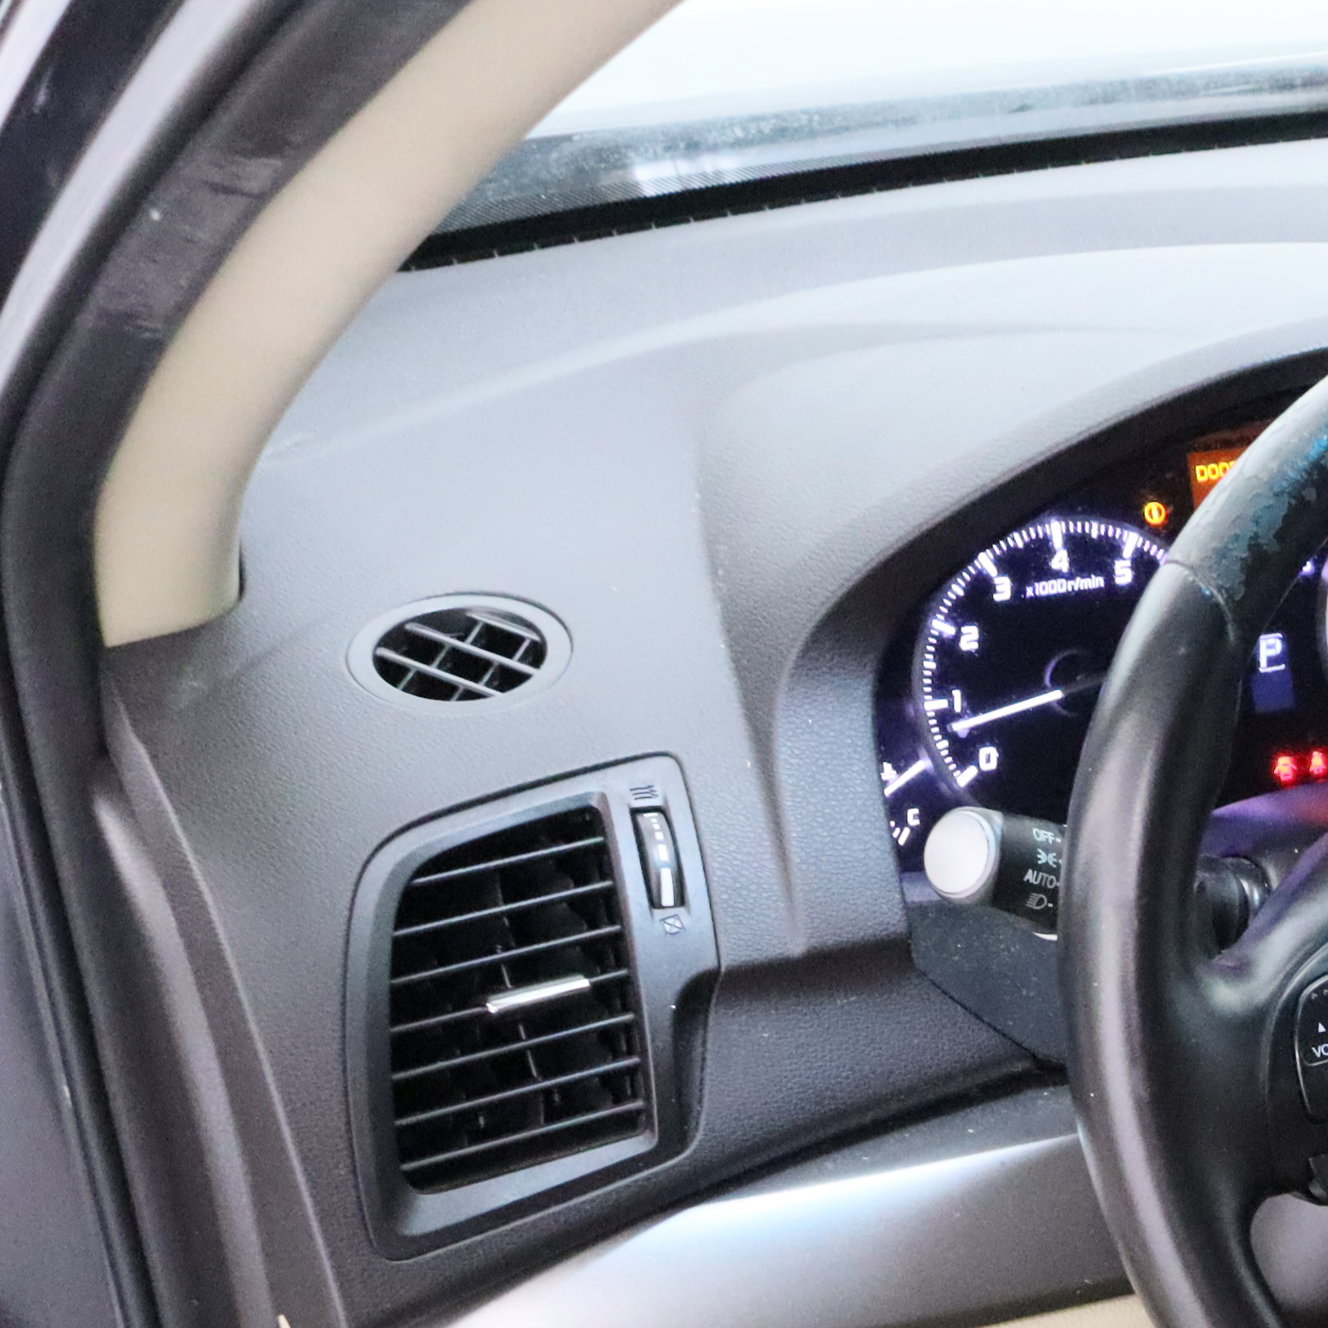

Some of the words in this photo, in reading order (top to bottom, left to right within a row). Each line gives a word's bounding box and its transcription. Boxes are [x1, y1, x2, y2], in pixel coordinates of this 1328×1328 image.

[1195, 461, 1236, 483] DOO
[1051, 549, 1069, 573] 4
[1114, 560, 1133, 585] 5
[993, 577, 1011, 602] 3
[960, 625, 979, 652] 2
[1259, 637, 1284, 669] P
[952, 690, 962, 713] 1
[978, 747, 998, 771] 0
[907, 808, 920, 826] C
[1032, 827, 1056, 843] OFF
[1023, 868, 1057, 890] AUTO
